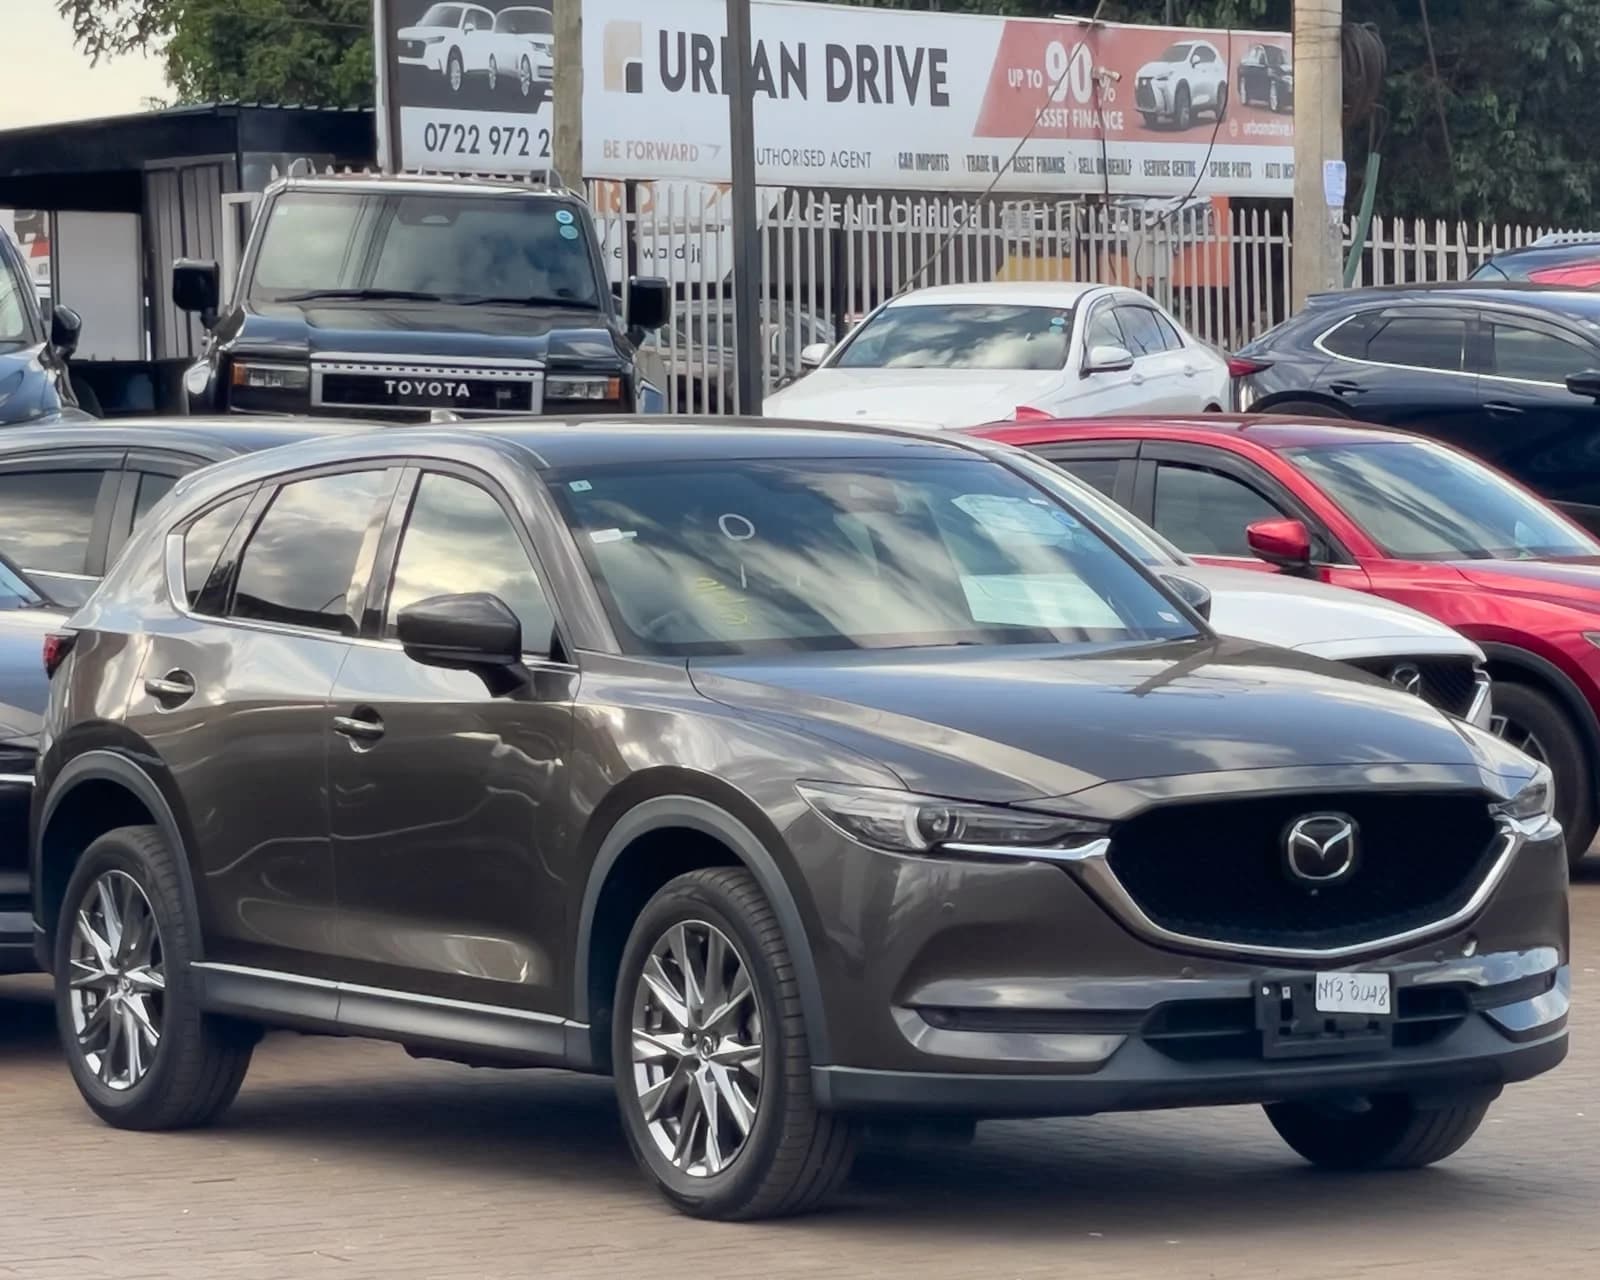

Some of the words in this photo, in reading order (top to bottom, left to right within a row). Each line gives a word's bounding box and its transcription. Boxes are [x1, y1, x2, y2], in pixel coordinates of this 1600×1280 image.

[825, 43, 949, 107] DRIVE
[1008, 68, 1024, 88] UP
[1026, 69, 1043, 89] TO
[1035, 108, 1069, 128] ASSET
[1072, 108, 1124, 131] FINANCE
[424, 122, 480, 154] 0722
[489, 126, 529, 156] 972
[602, 139, 621, 160] BE
[626, 140, 700, 163] FORWARD
[756, 148, 826, 168] UTHORISED
[831, 150, 872, 169] AGENT
[898, 152, 914, 171] CAR
[916, 153, 950, 172] IMPORTS
[966, 154, 990, 173] TRADE
[1013, 156, 1034, 173] ASSET
[384, 380, 470, 398] TOYOTA
